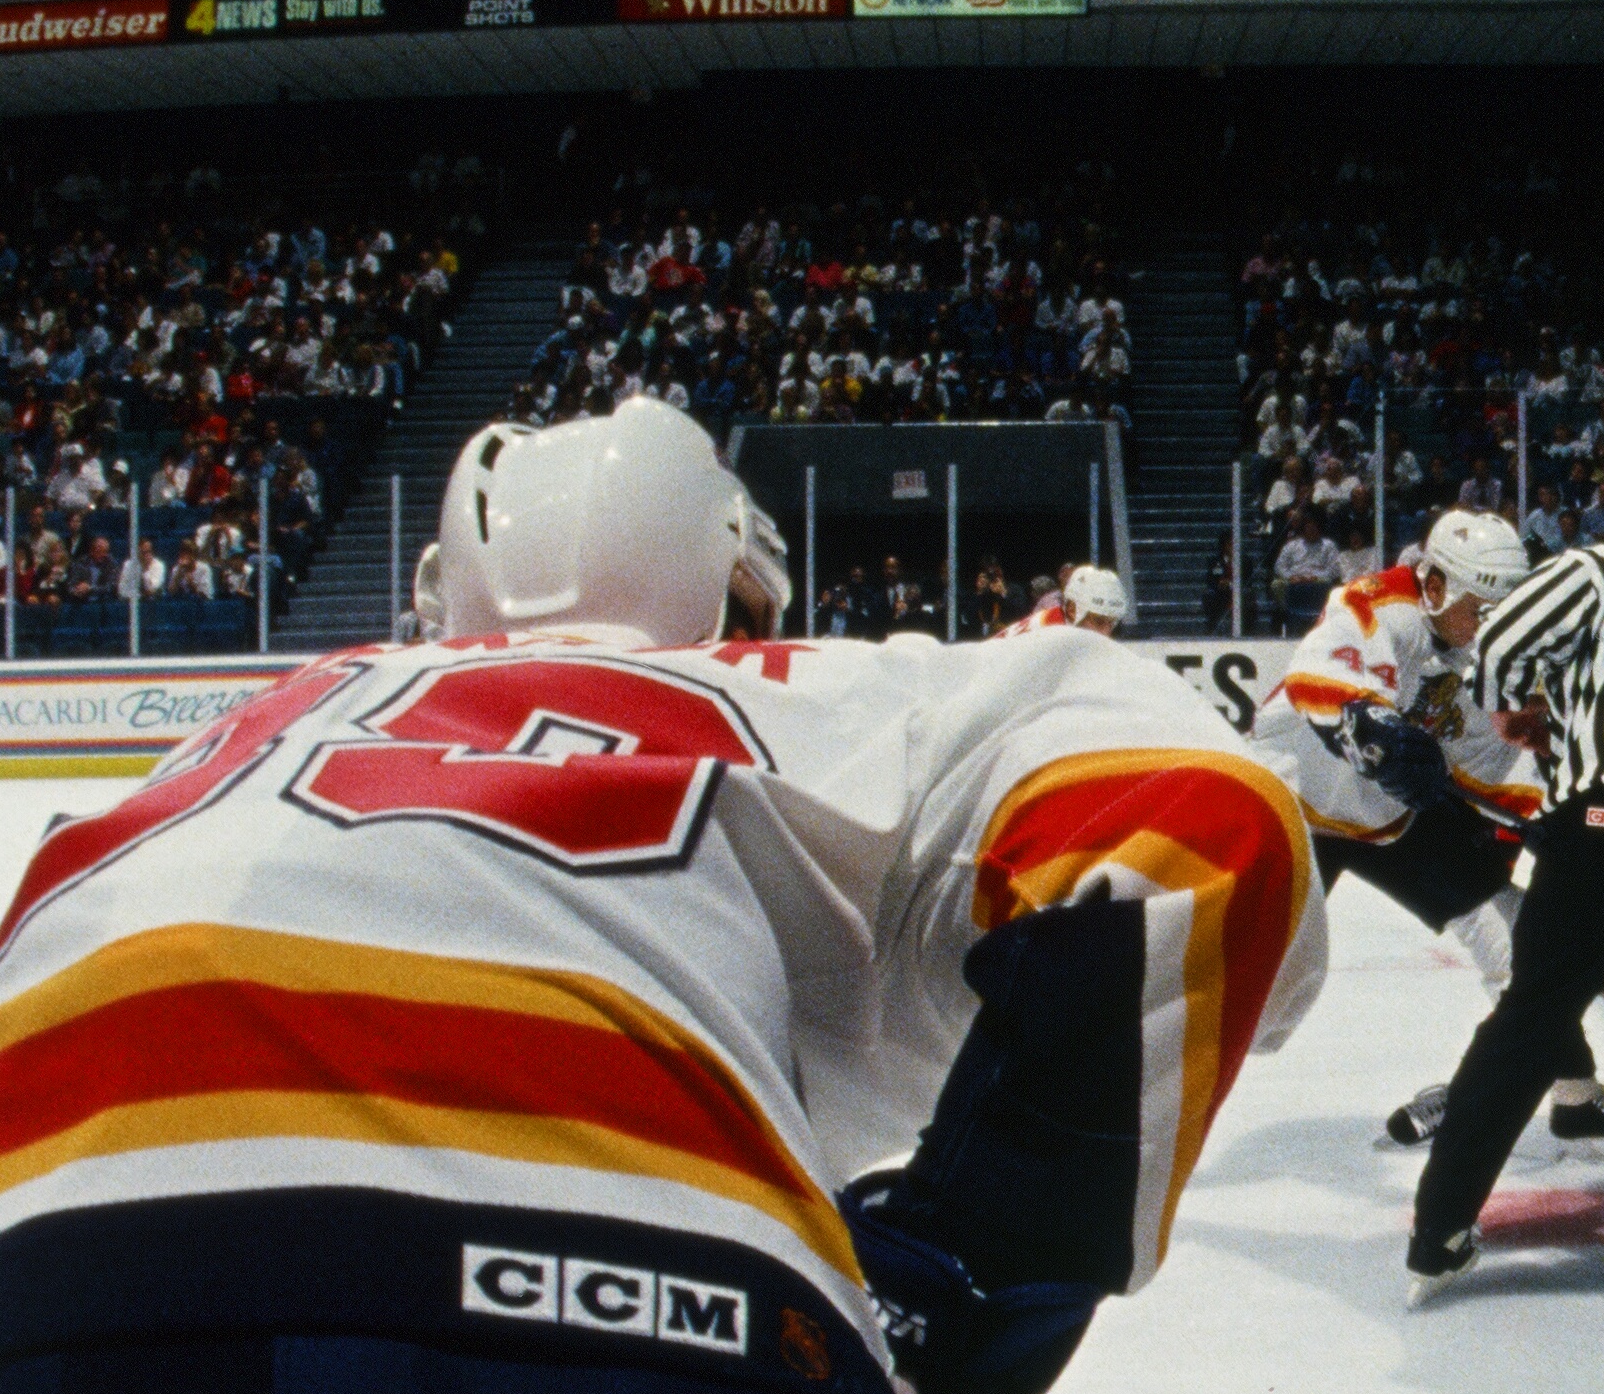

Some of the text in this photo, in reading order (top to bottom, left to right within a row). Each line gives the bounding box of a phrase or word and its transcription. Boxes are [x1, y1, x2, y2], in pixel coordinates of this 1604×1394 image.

[464, 9, 536, 26] SHOTS
[1330, 646, 1397, 690] 44
[473, 1256, 740, 1343] CCM
